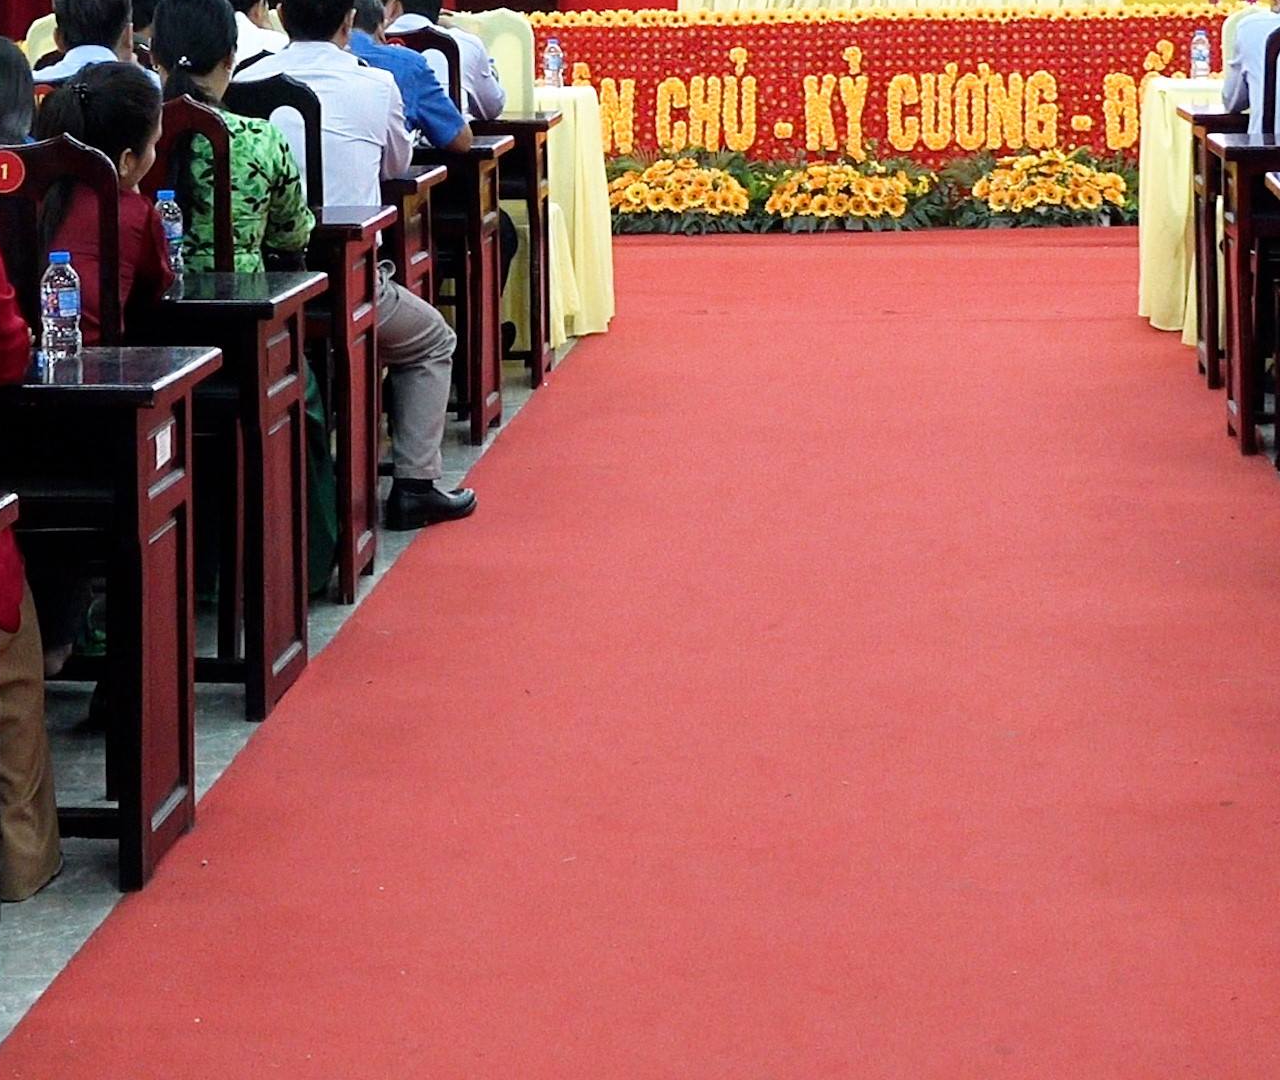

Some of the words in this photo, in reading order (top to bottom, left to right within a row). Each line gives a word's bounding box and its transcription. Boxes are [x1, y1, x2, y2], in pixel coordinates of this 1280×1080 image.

[655, 46, 757, 153] CHỦ
[886, 62, 1058, 152] CƯƠNG
[0, 163, 8, 180] 1
